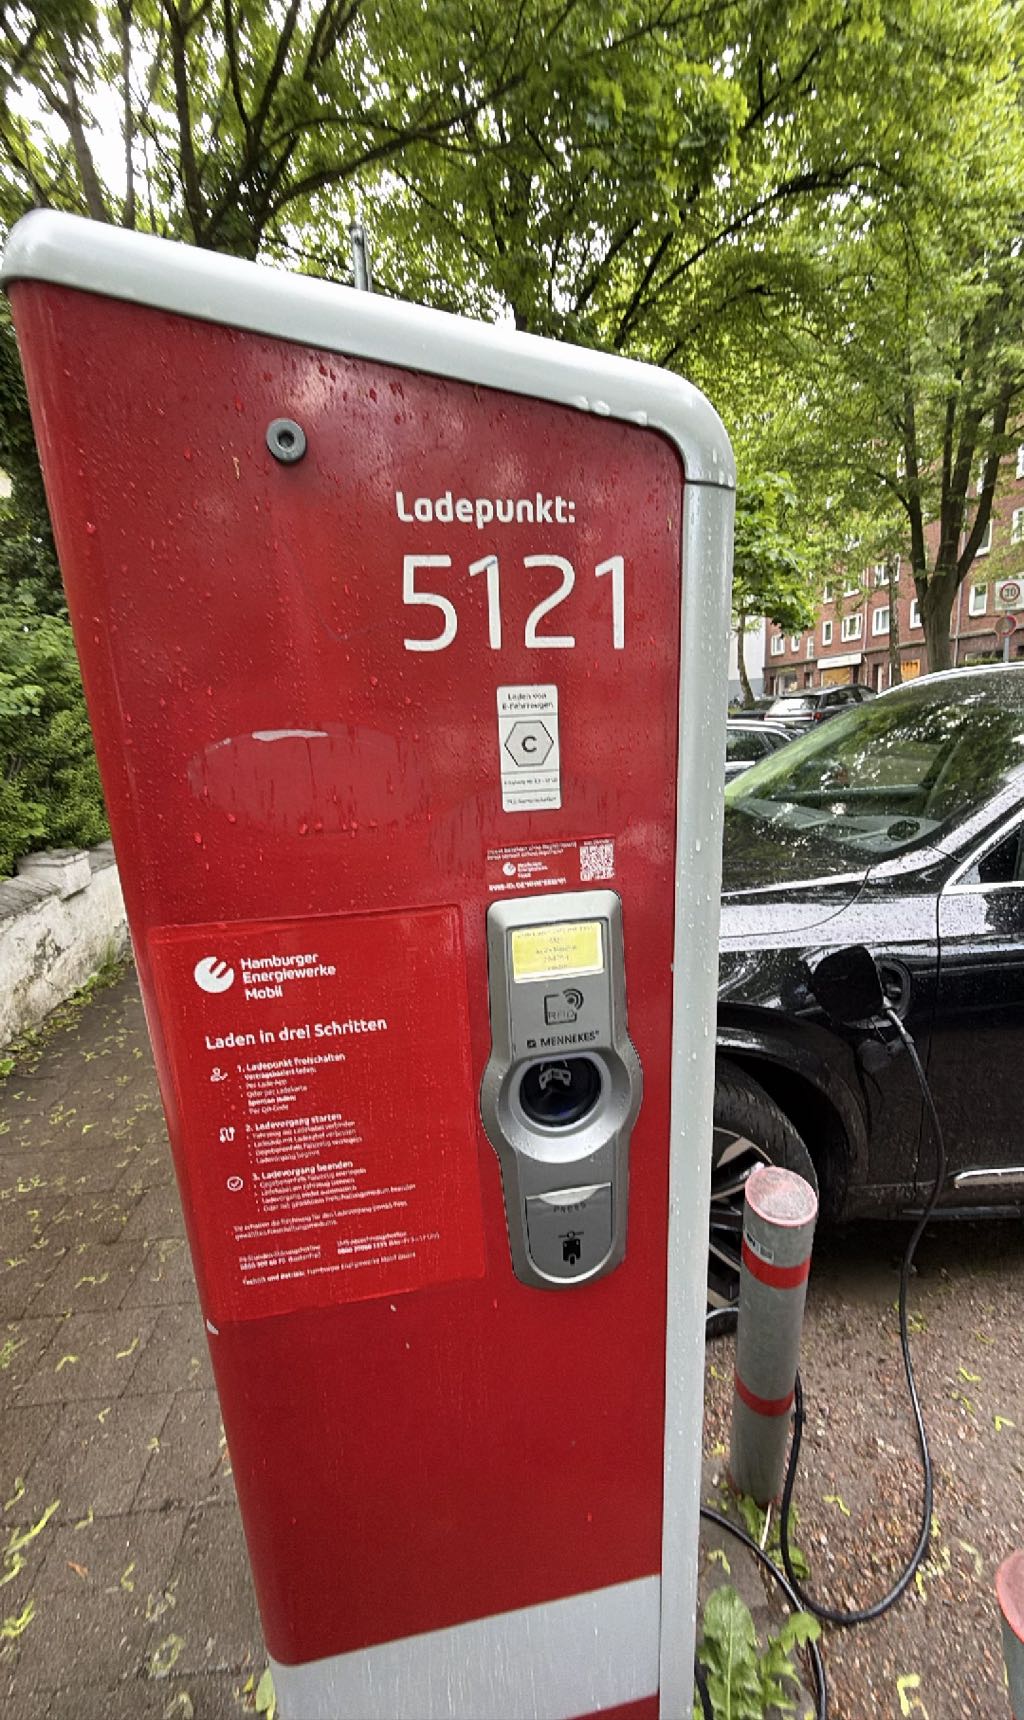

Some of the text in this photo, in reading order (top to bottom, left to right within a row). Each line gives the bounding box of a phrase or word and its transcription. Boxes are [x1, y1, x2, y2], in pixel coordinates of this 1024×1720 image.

[395, 490, 576, 530] Ladepunkt:
[402, 554, 625, 651] 5121
[521, 735, 537, 753] C
[240, 953, 319, 971] Hamburger
[242, 964, 337, 984] Energiewerke
[245, 986, 284, 1001] Mobil
[205, 1017, 388, 1050] Laden in drei Schritten
